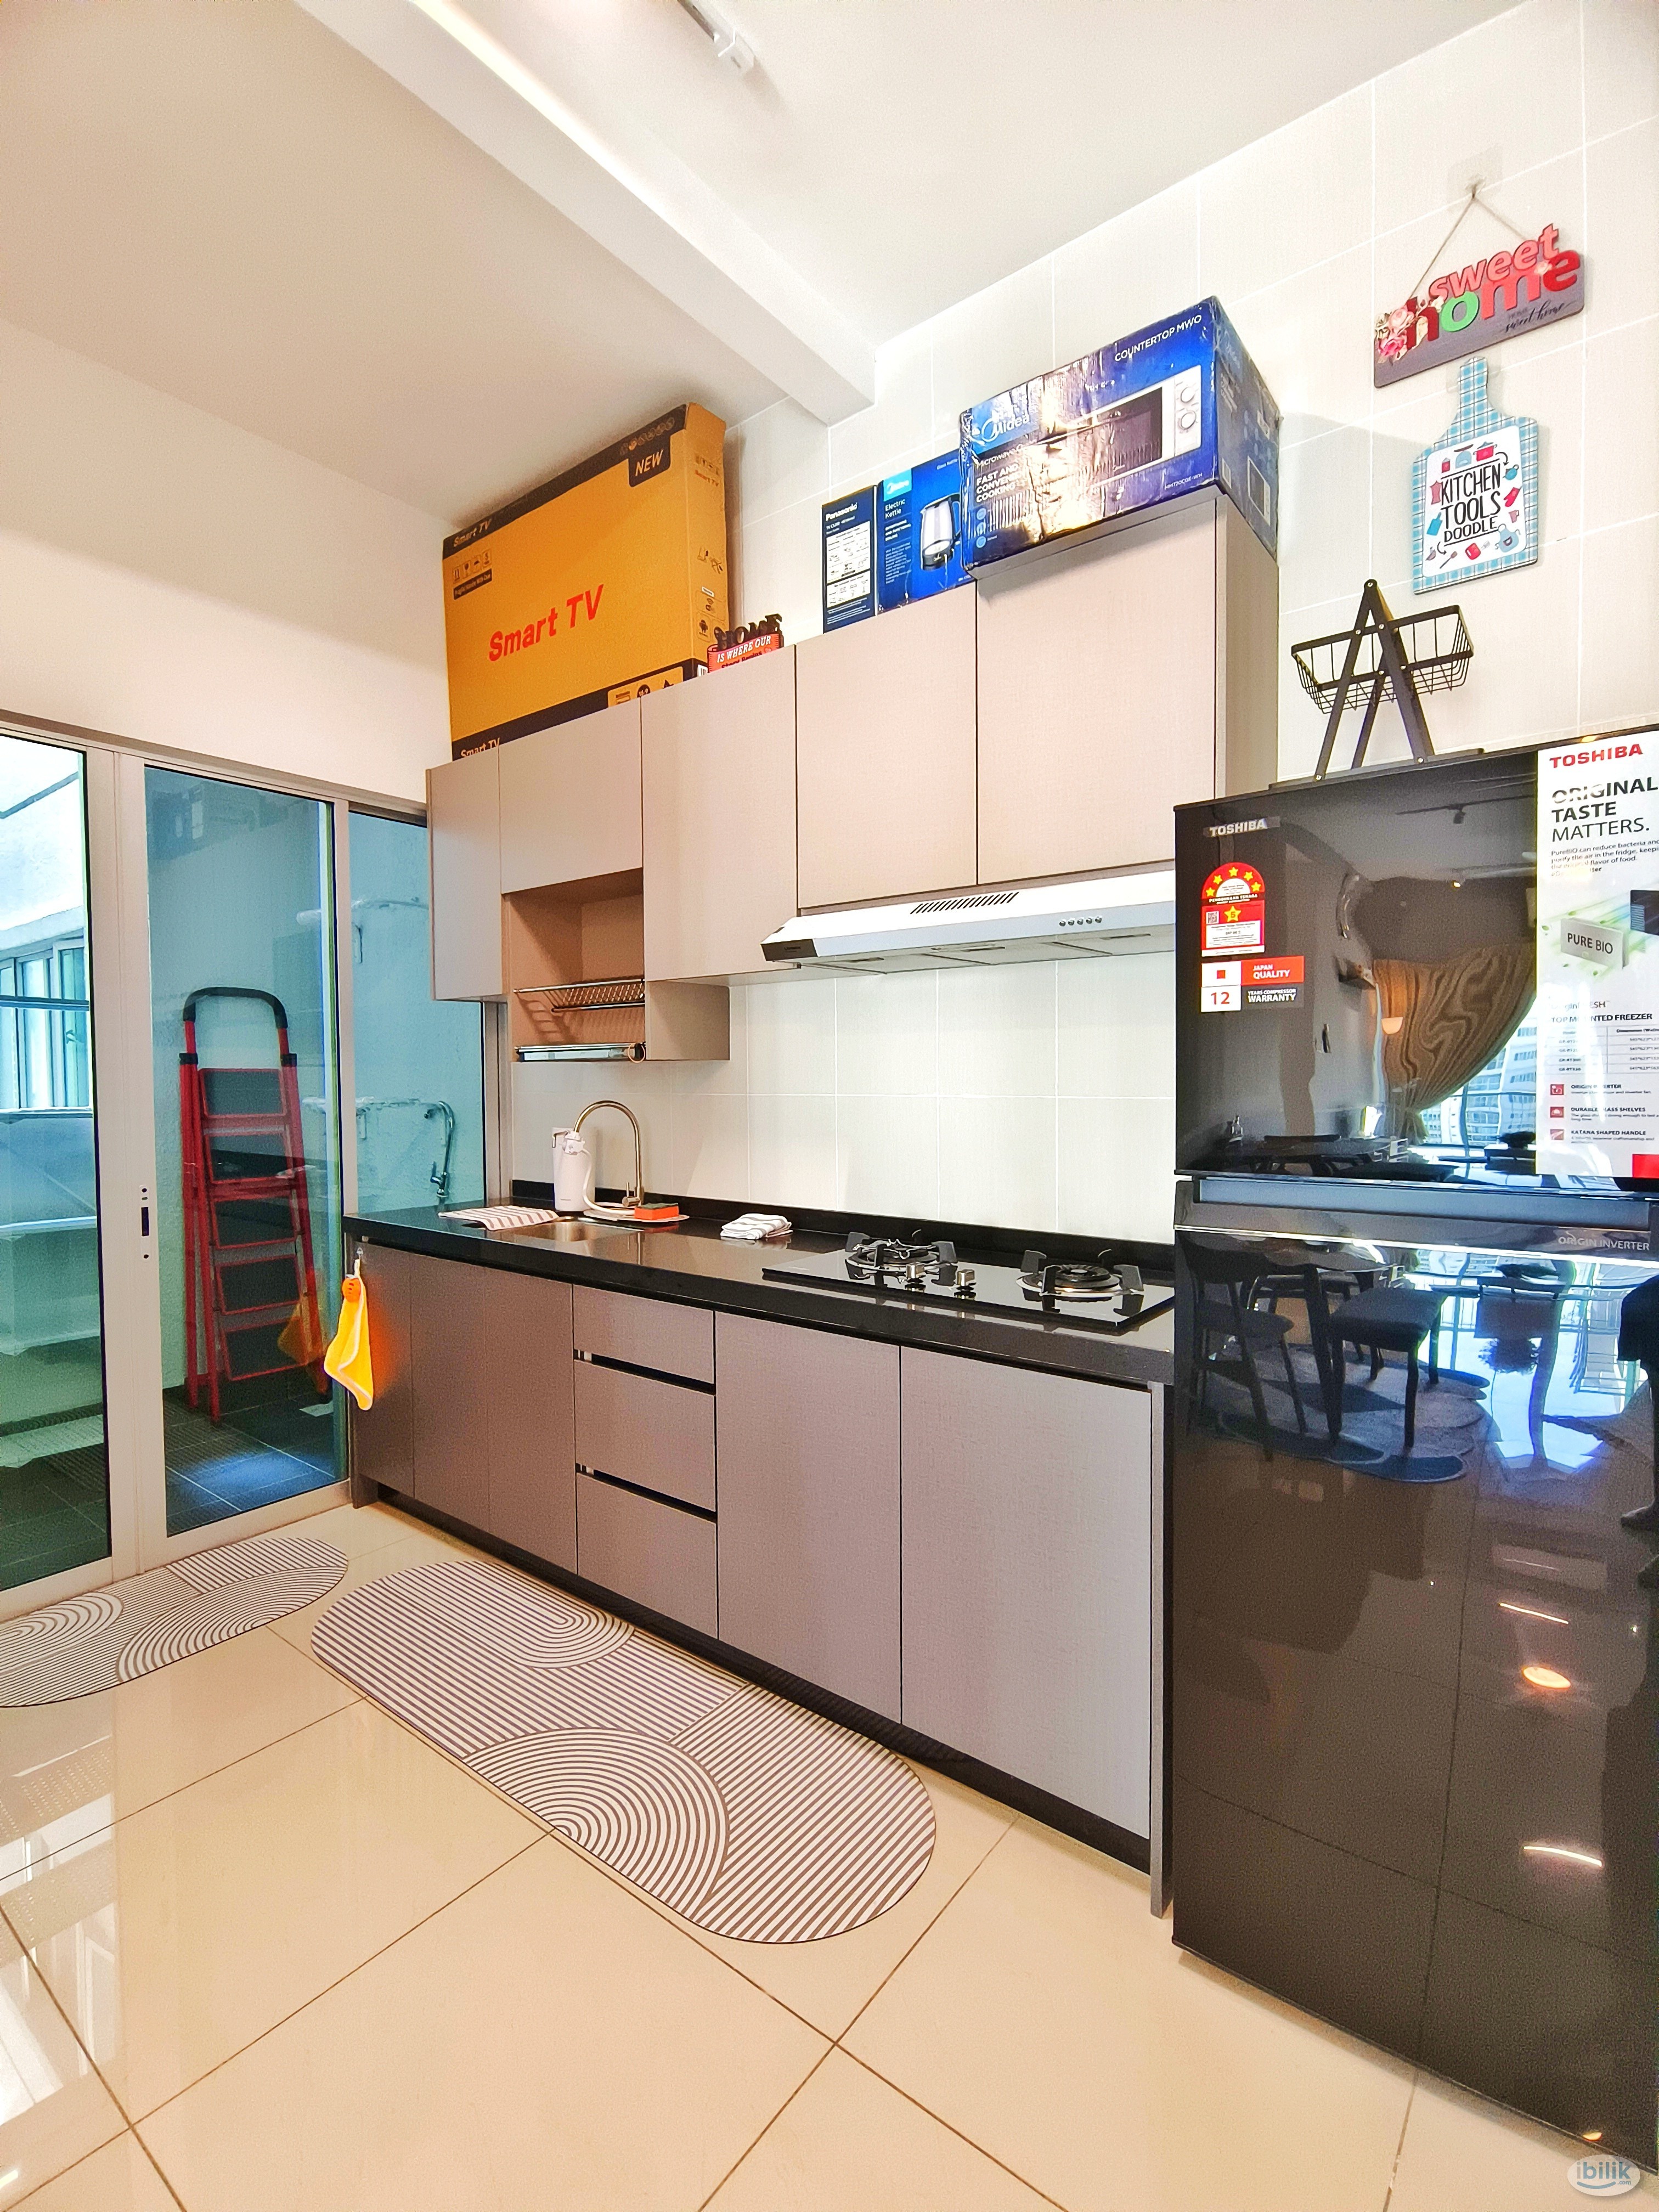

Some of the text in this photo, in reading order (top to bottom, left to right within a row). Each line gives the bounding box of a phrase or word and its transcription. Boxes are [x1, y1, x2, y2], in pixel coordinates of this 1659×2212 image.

[1429, 223, 1559, 300] sweet
[1406, 250, 1581, 350] home
[1115, 315, 1202, 362] COUNTERTOP MWO
[635, 449, 664, 476] NEW
[977, 463, 1019, 486] FAST AND
[977, 482, 1016, 503] COOKING
[1441, 462, 1501, 506] KITCHEN
[826, 502, 857, 521] Panasonic
[885, 499, 906, 511] Electric
[885, 508, 901, 519] Kettle
[1440, 490, 1501, 529] TOOLS
[453, 518, 492, 547] Smart TV
[1443, 515, 1499, 543] DOODLE
[489, 584, 603, 662] Smart TV
[716, 635, 771, 663] IS WHERE OUR
[460, 737, 500, 757] Smart TV
[1549, 743, 1643, 769] TOSHIBA
[1551, 777, 1658, 804] ORIGINAL
[1551, 801, 1617, 823] TASTE
[1209, 818, 1268, 838] TOSHIBA
[1552, 817, 1650, 842] MATTERS.
[1567, 933, 1613, 954] PURE BIO
[1253, 969, 1290, 979] QUALITY
[1211, 991, 1230, 1005] 12
[1248, 993, 1296, 1003] WARRANTY
[1558, 1232, 1650, 1251] ORIGIN INVERTER
